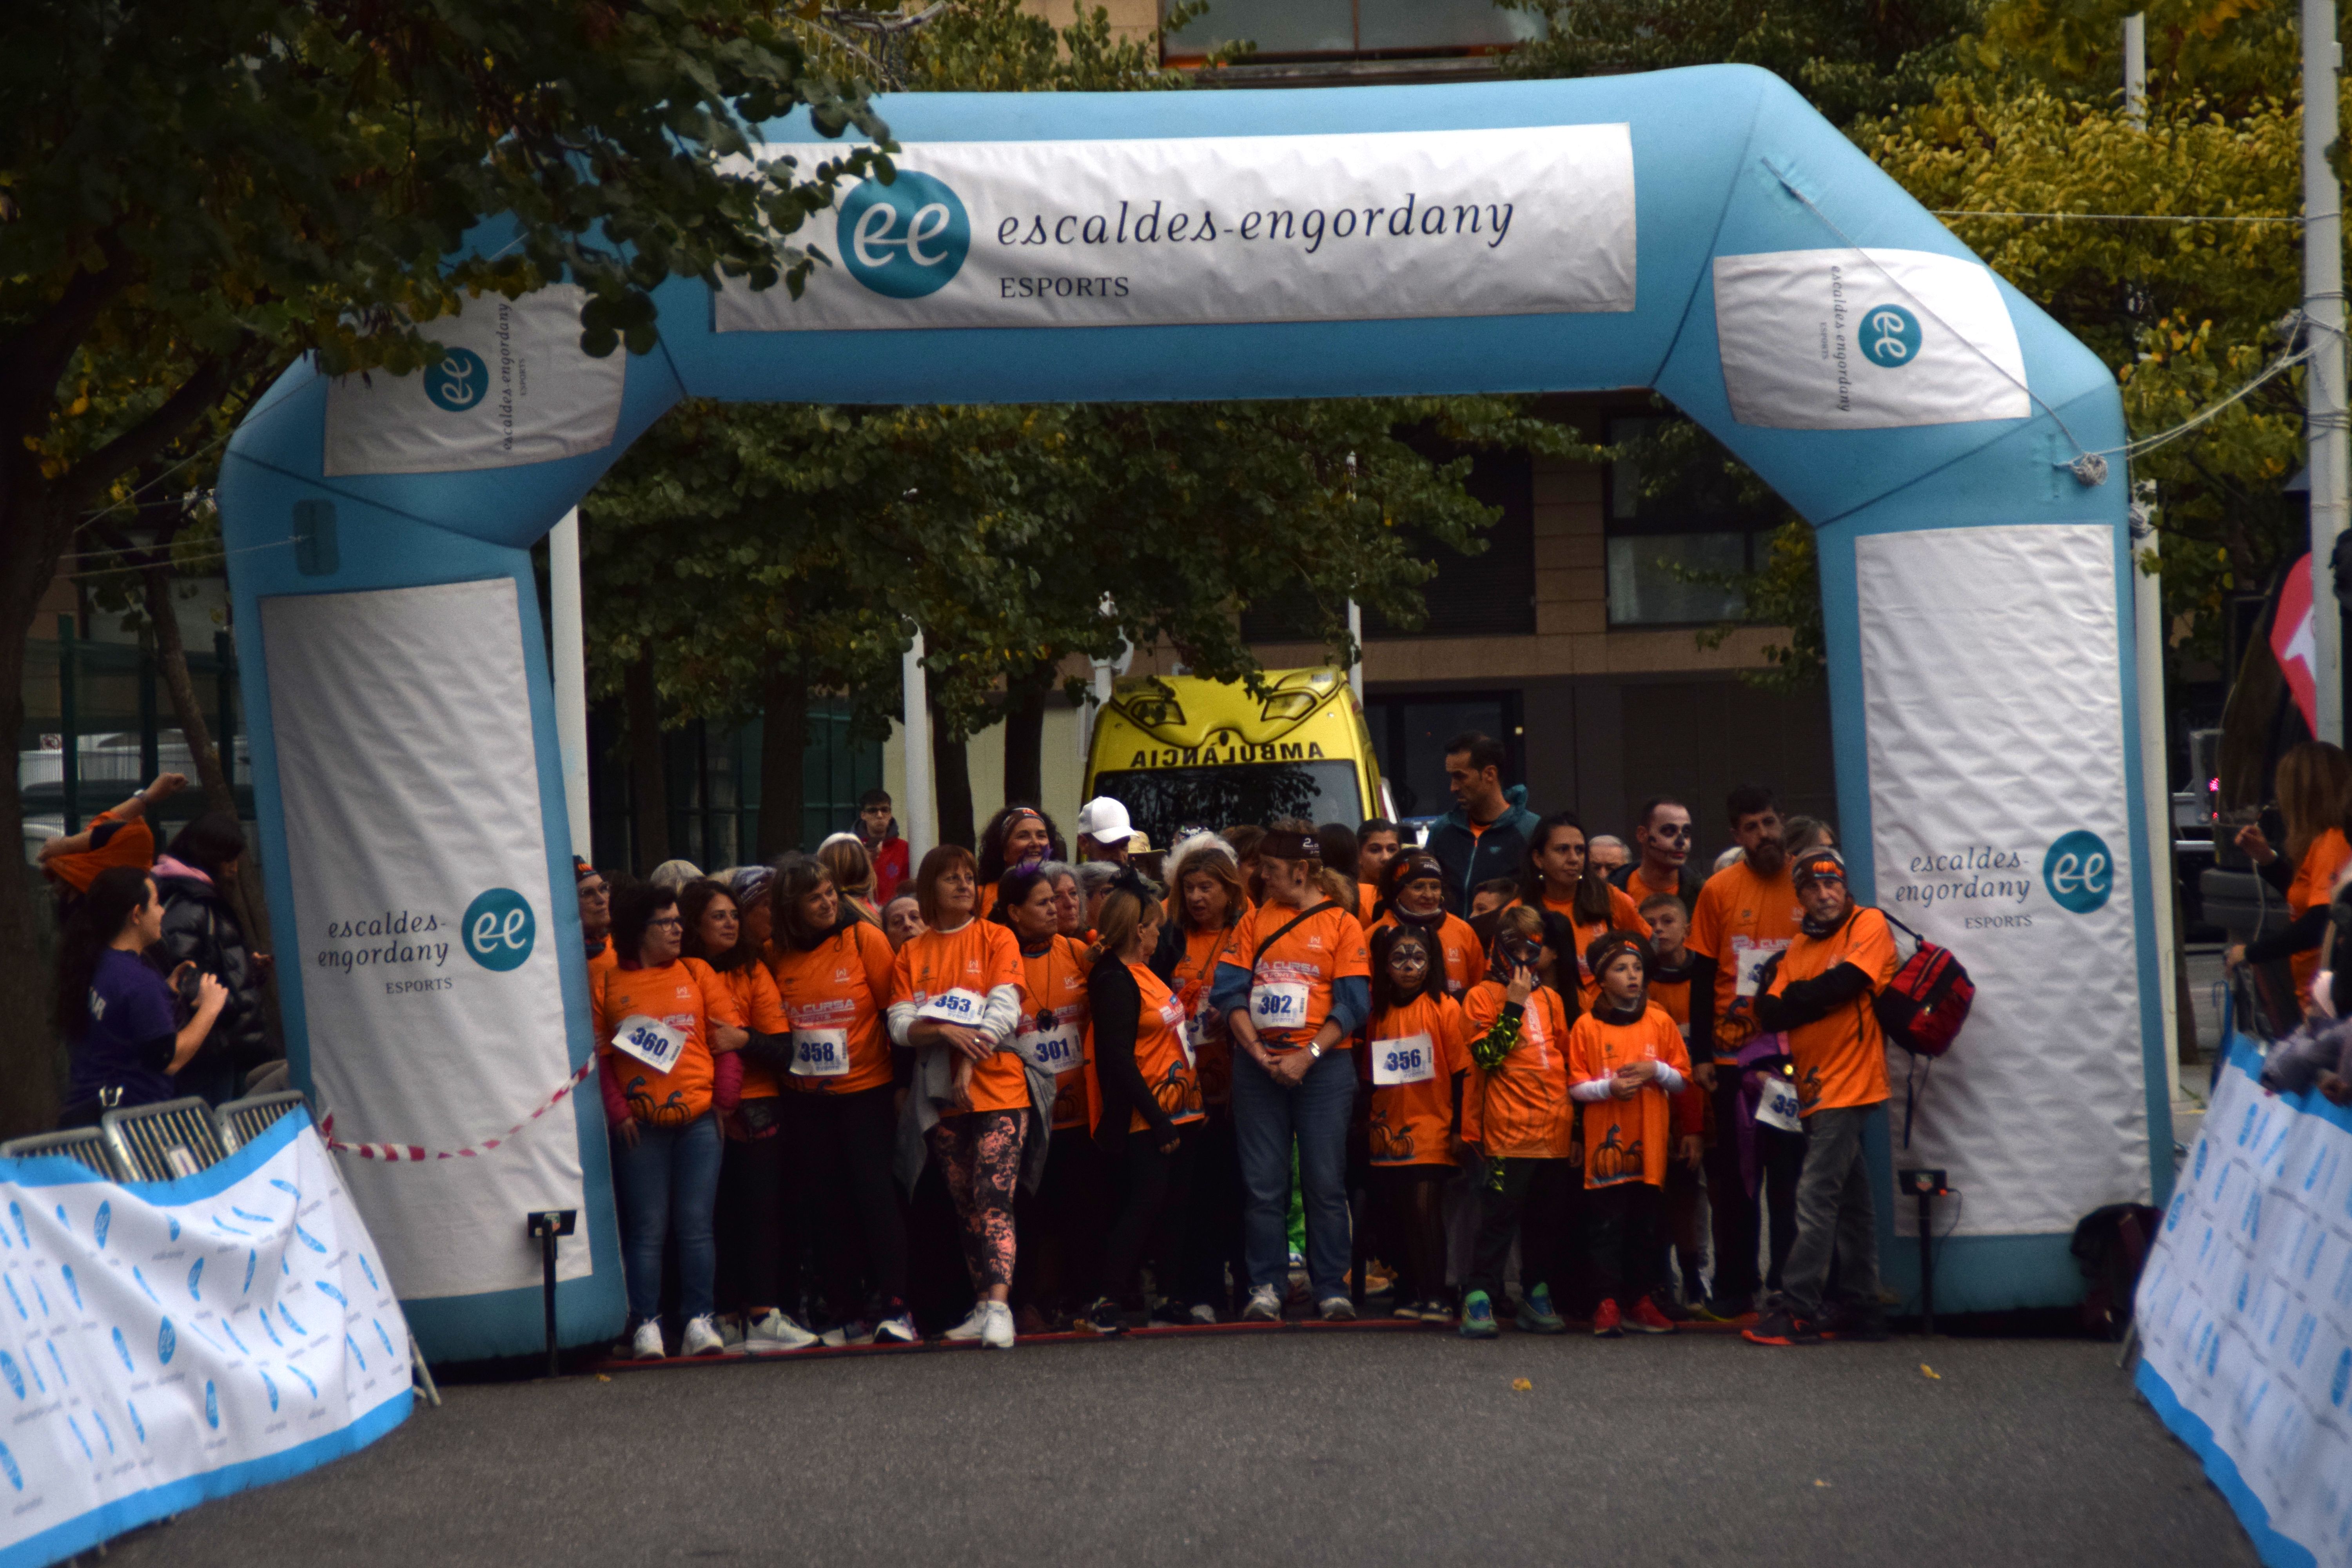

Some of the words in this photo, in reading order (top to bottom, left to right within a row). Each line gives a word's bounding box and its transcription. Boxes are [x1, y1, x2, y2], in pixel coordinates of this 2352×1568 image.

[997, 192, 1514, 254] escaldes-engordany
[1000, 276, 1129, 298] ESPORTS
[519, 358, 527, 396] ESPORTS
[1895, 875, 2031, 908] engordany
[1965, 914, 2033, 929] ESPORTS
[318, 942, 449, 974] engordany
[386, 977, 453, 994] ESPORTS
[935, 995, 971, 1013] 353
[1260, 995, 1292, 1015] 302
[631, 1027, 669, 1056] 360
[800, 1042, 834, 1062] 358
[1036, 1038, 1070, 1062] 301
[1387, 1048, 1421, 1071] 356
[1773, 1094, 1799, 1117] 35
